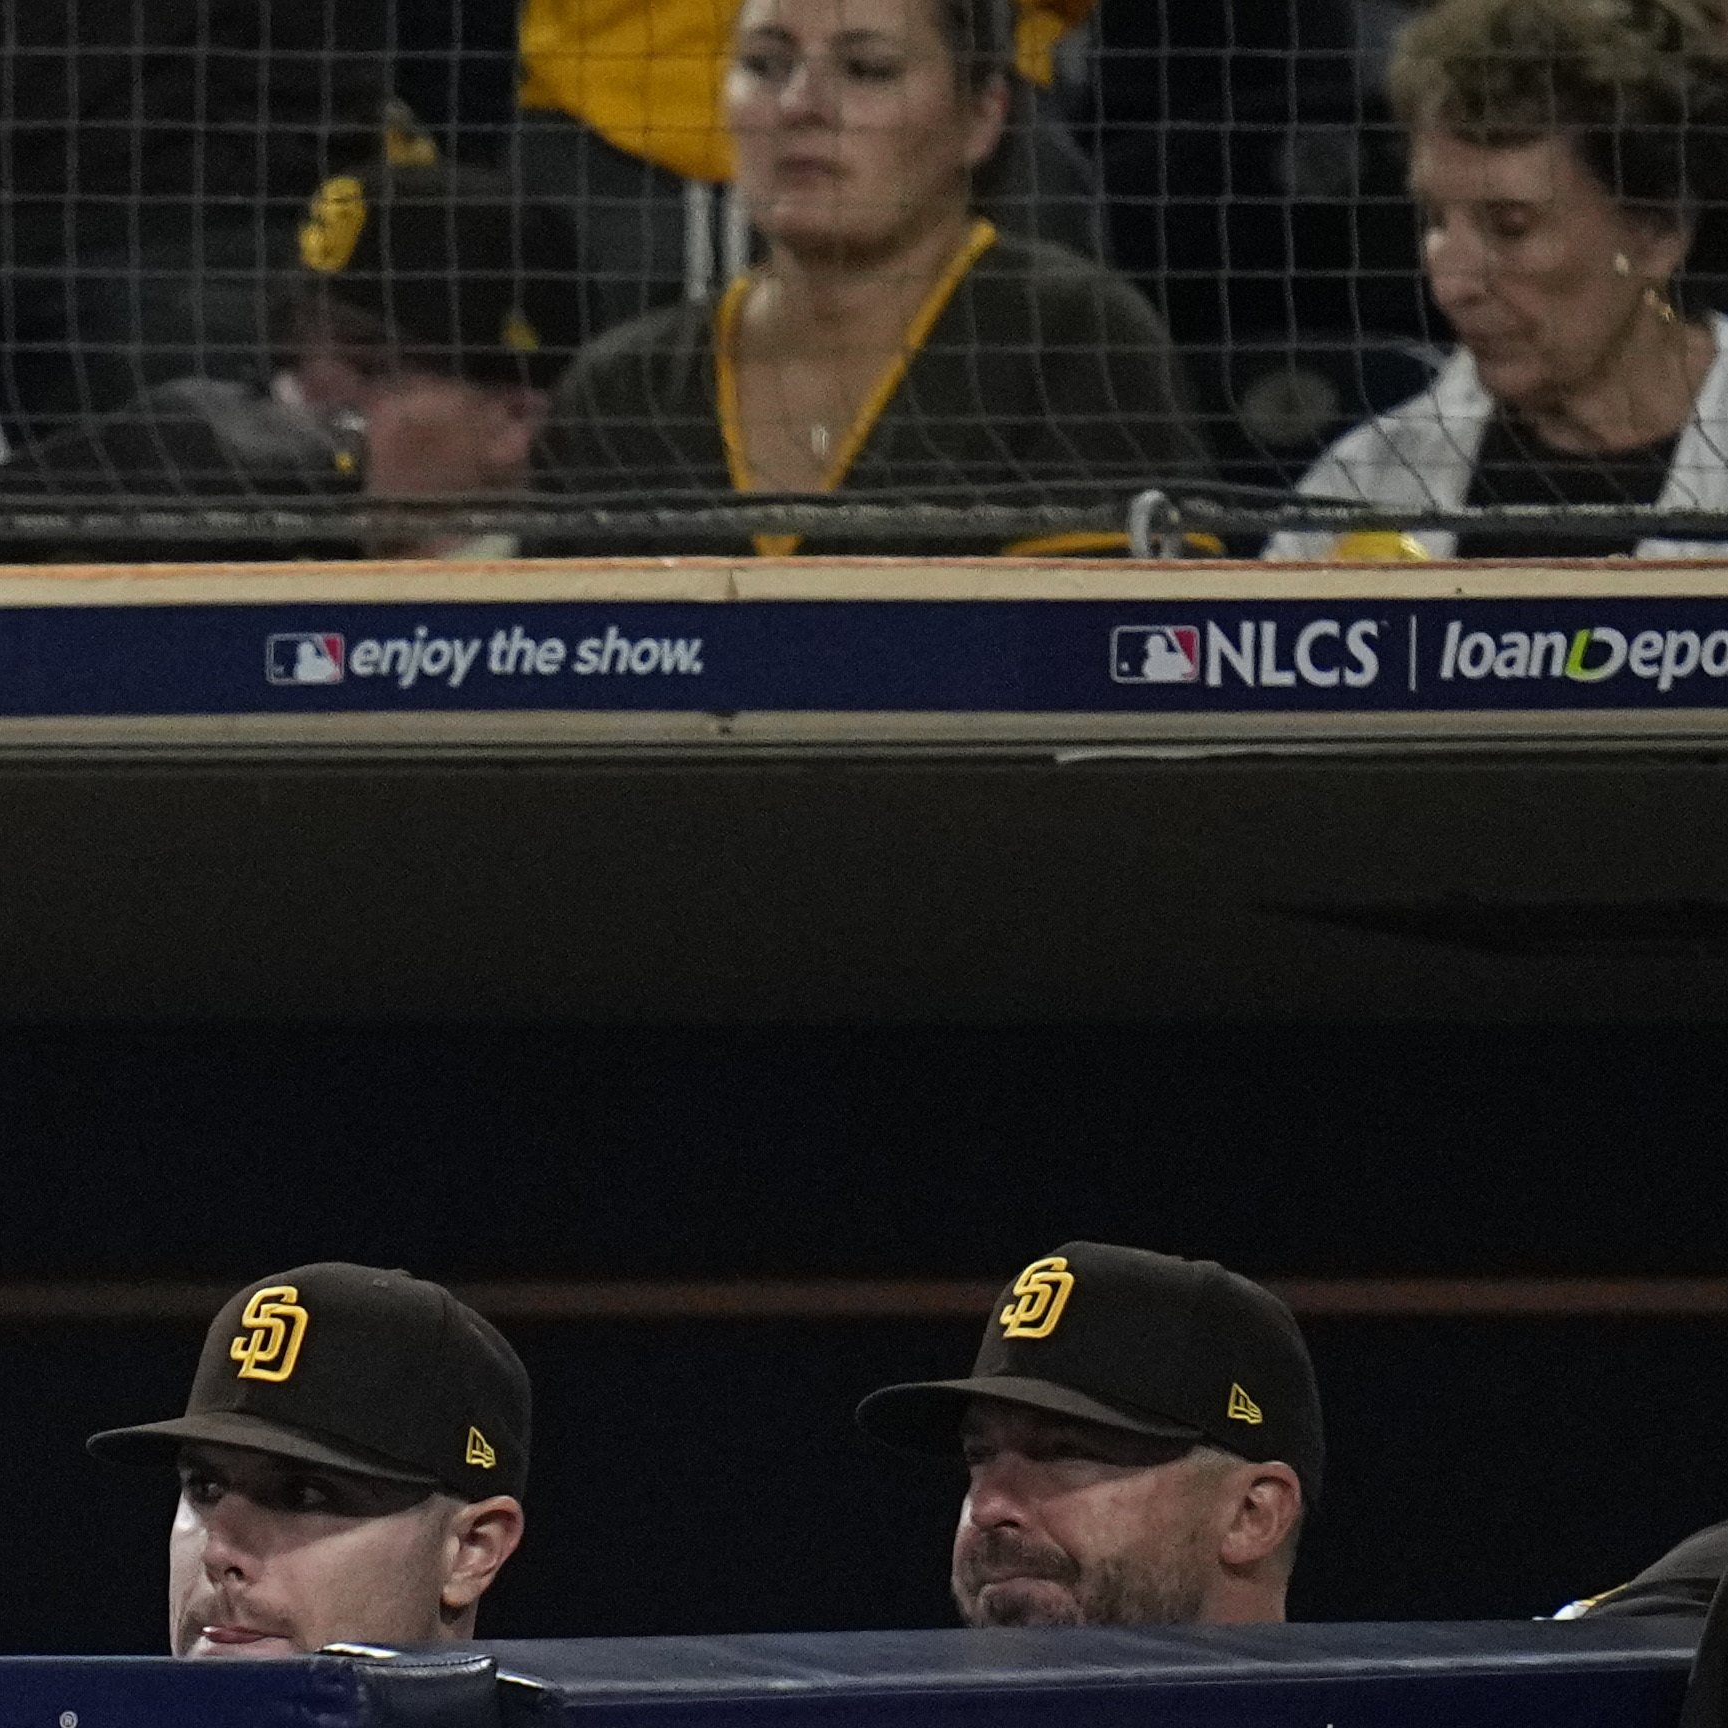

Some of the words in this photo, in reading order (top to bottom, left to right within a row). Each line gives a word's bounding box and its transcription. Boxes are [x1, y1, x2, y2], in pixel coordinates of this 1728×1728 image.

[348, 624, 482, 690] enjoy
[486, 624, 567, 676] the
[570, 624, 705, 676] show.
[1204, 618, 1381, 688] NLCS
[230, 1285, 309, 1382] SD
[999, 1256, 1075, 1339] SD
